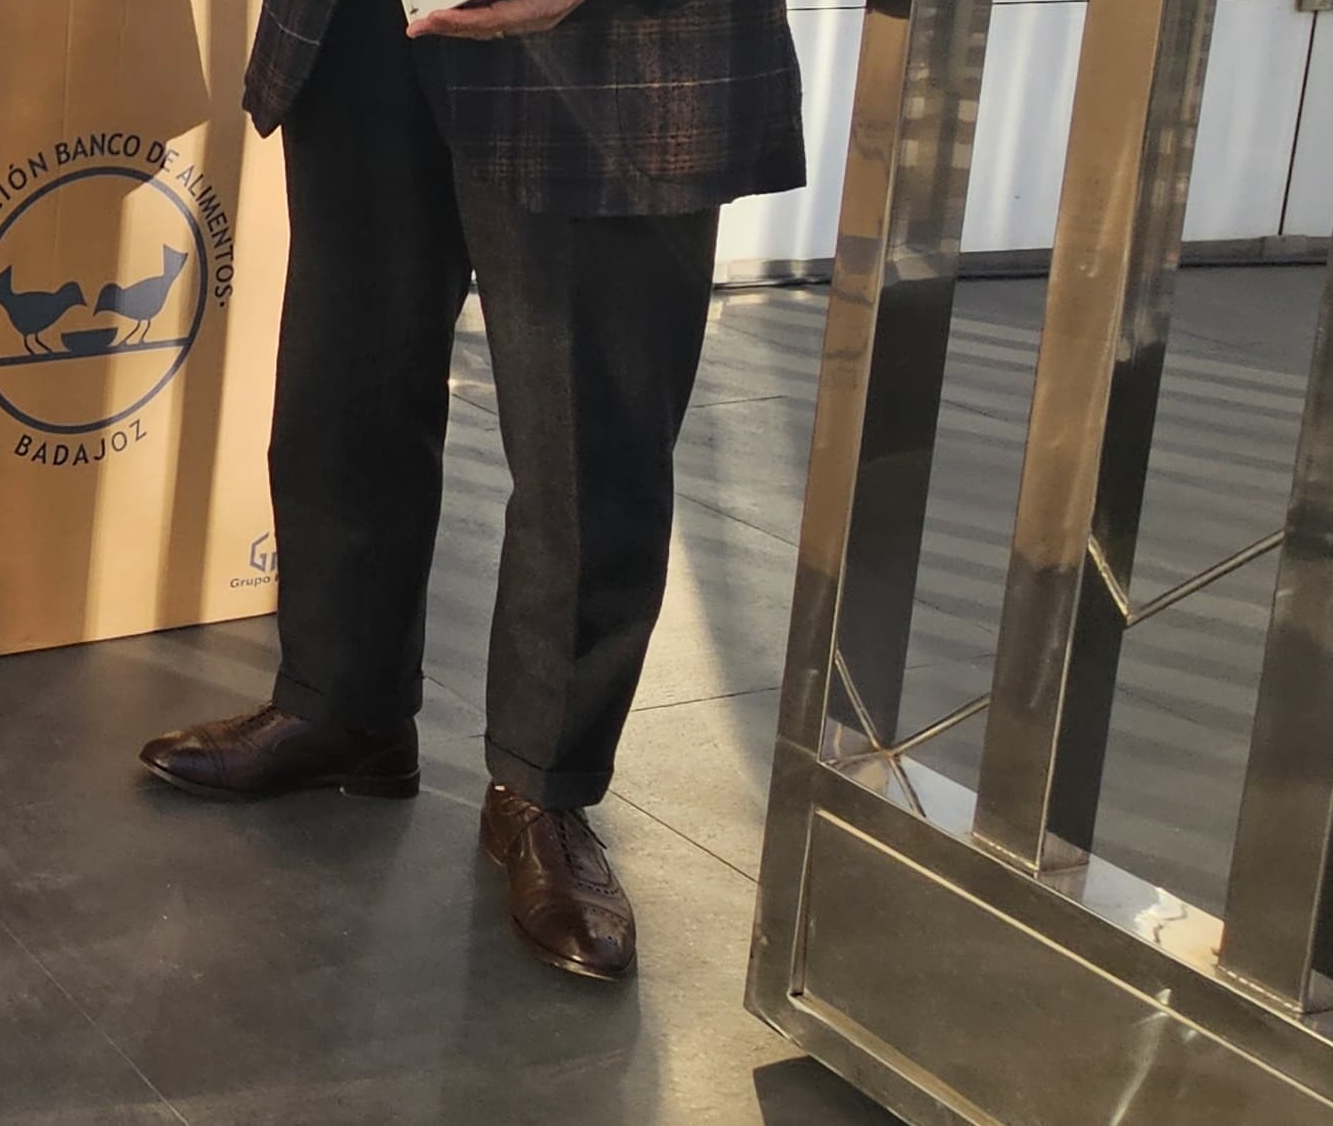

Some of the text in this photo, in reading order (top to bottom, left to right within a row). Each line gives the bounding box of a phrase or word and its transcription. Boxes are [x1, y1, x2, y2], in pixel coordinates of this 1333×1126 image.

[54, 132, 141, 166] BANCO
[146, 140, 180, 173] DE
[176, 164, 236, 299] ALIMENTOS
[14, 419, 148, 466] BADAJOZ
[229, 575, 271, 588] Grupo
